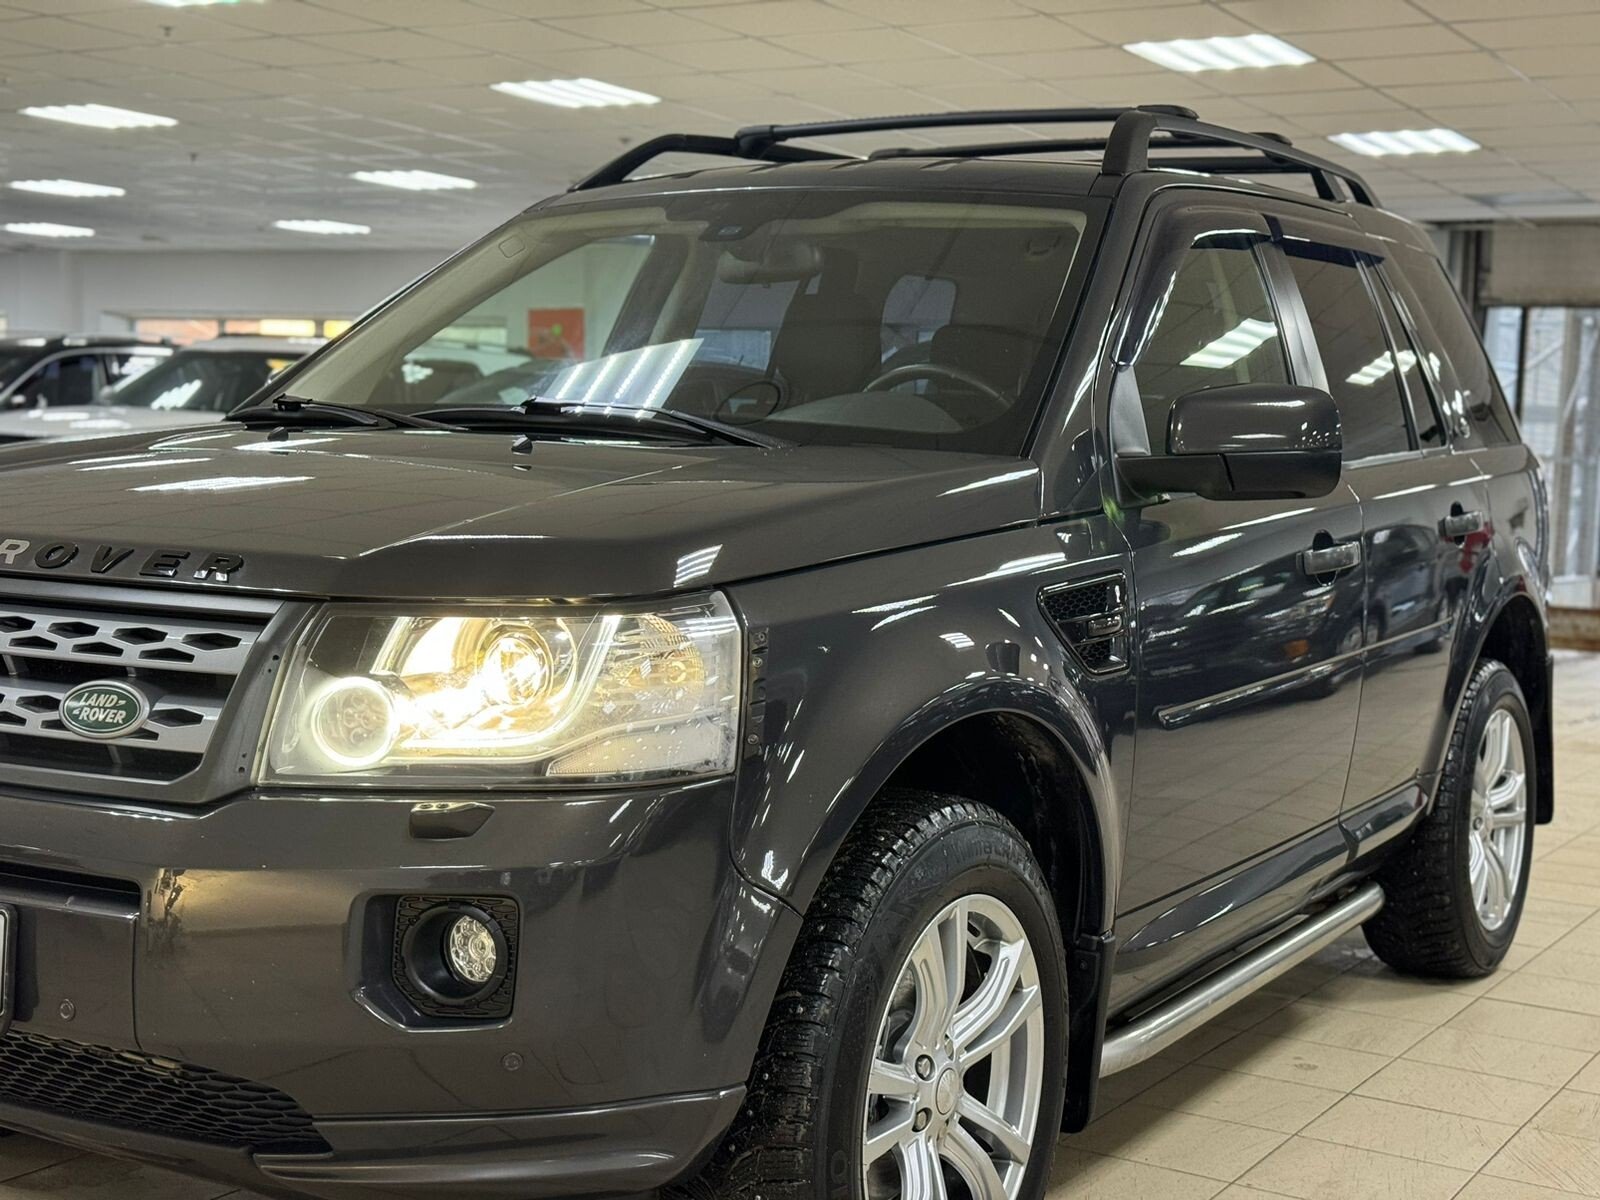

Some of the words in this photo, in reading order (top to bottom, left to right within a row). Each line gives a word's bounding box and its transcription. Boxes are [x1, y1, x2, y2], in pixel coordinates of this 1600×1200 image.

[0, 538, 244, 582] ROVER
[79, 692, 119, 708] LAND
[78, 706, 127, 724] ROVER
